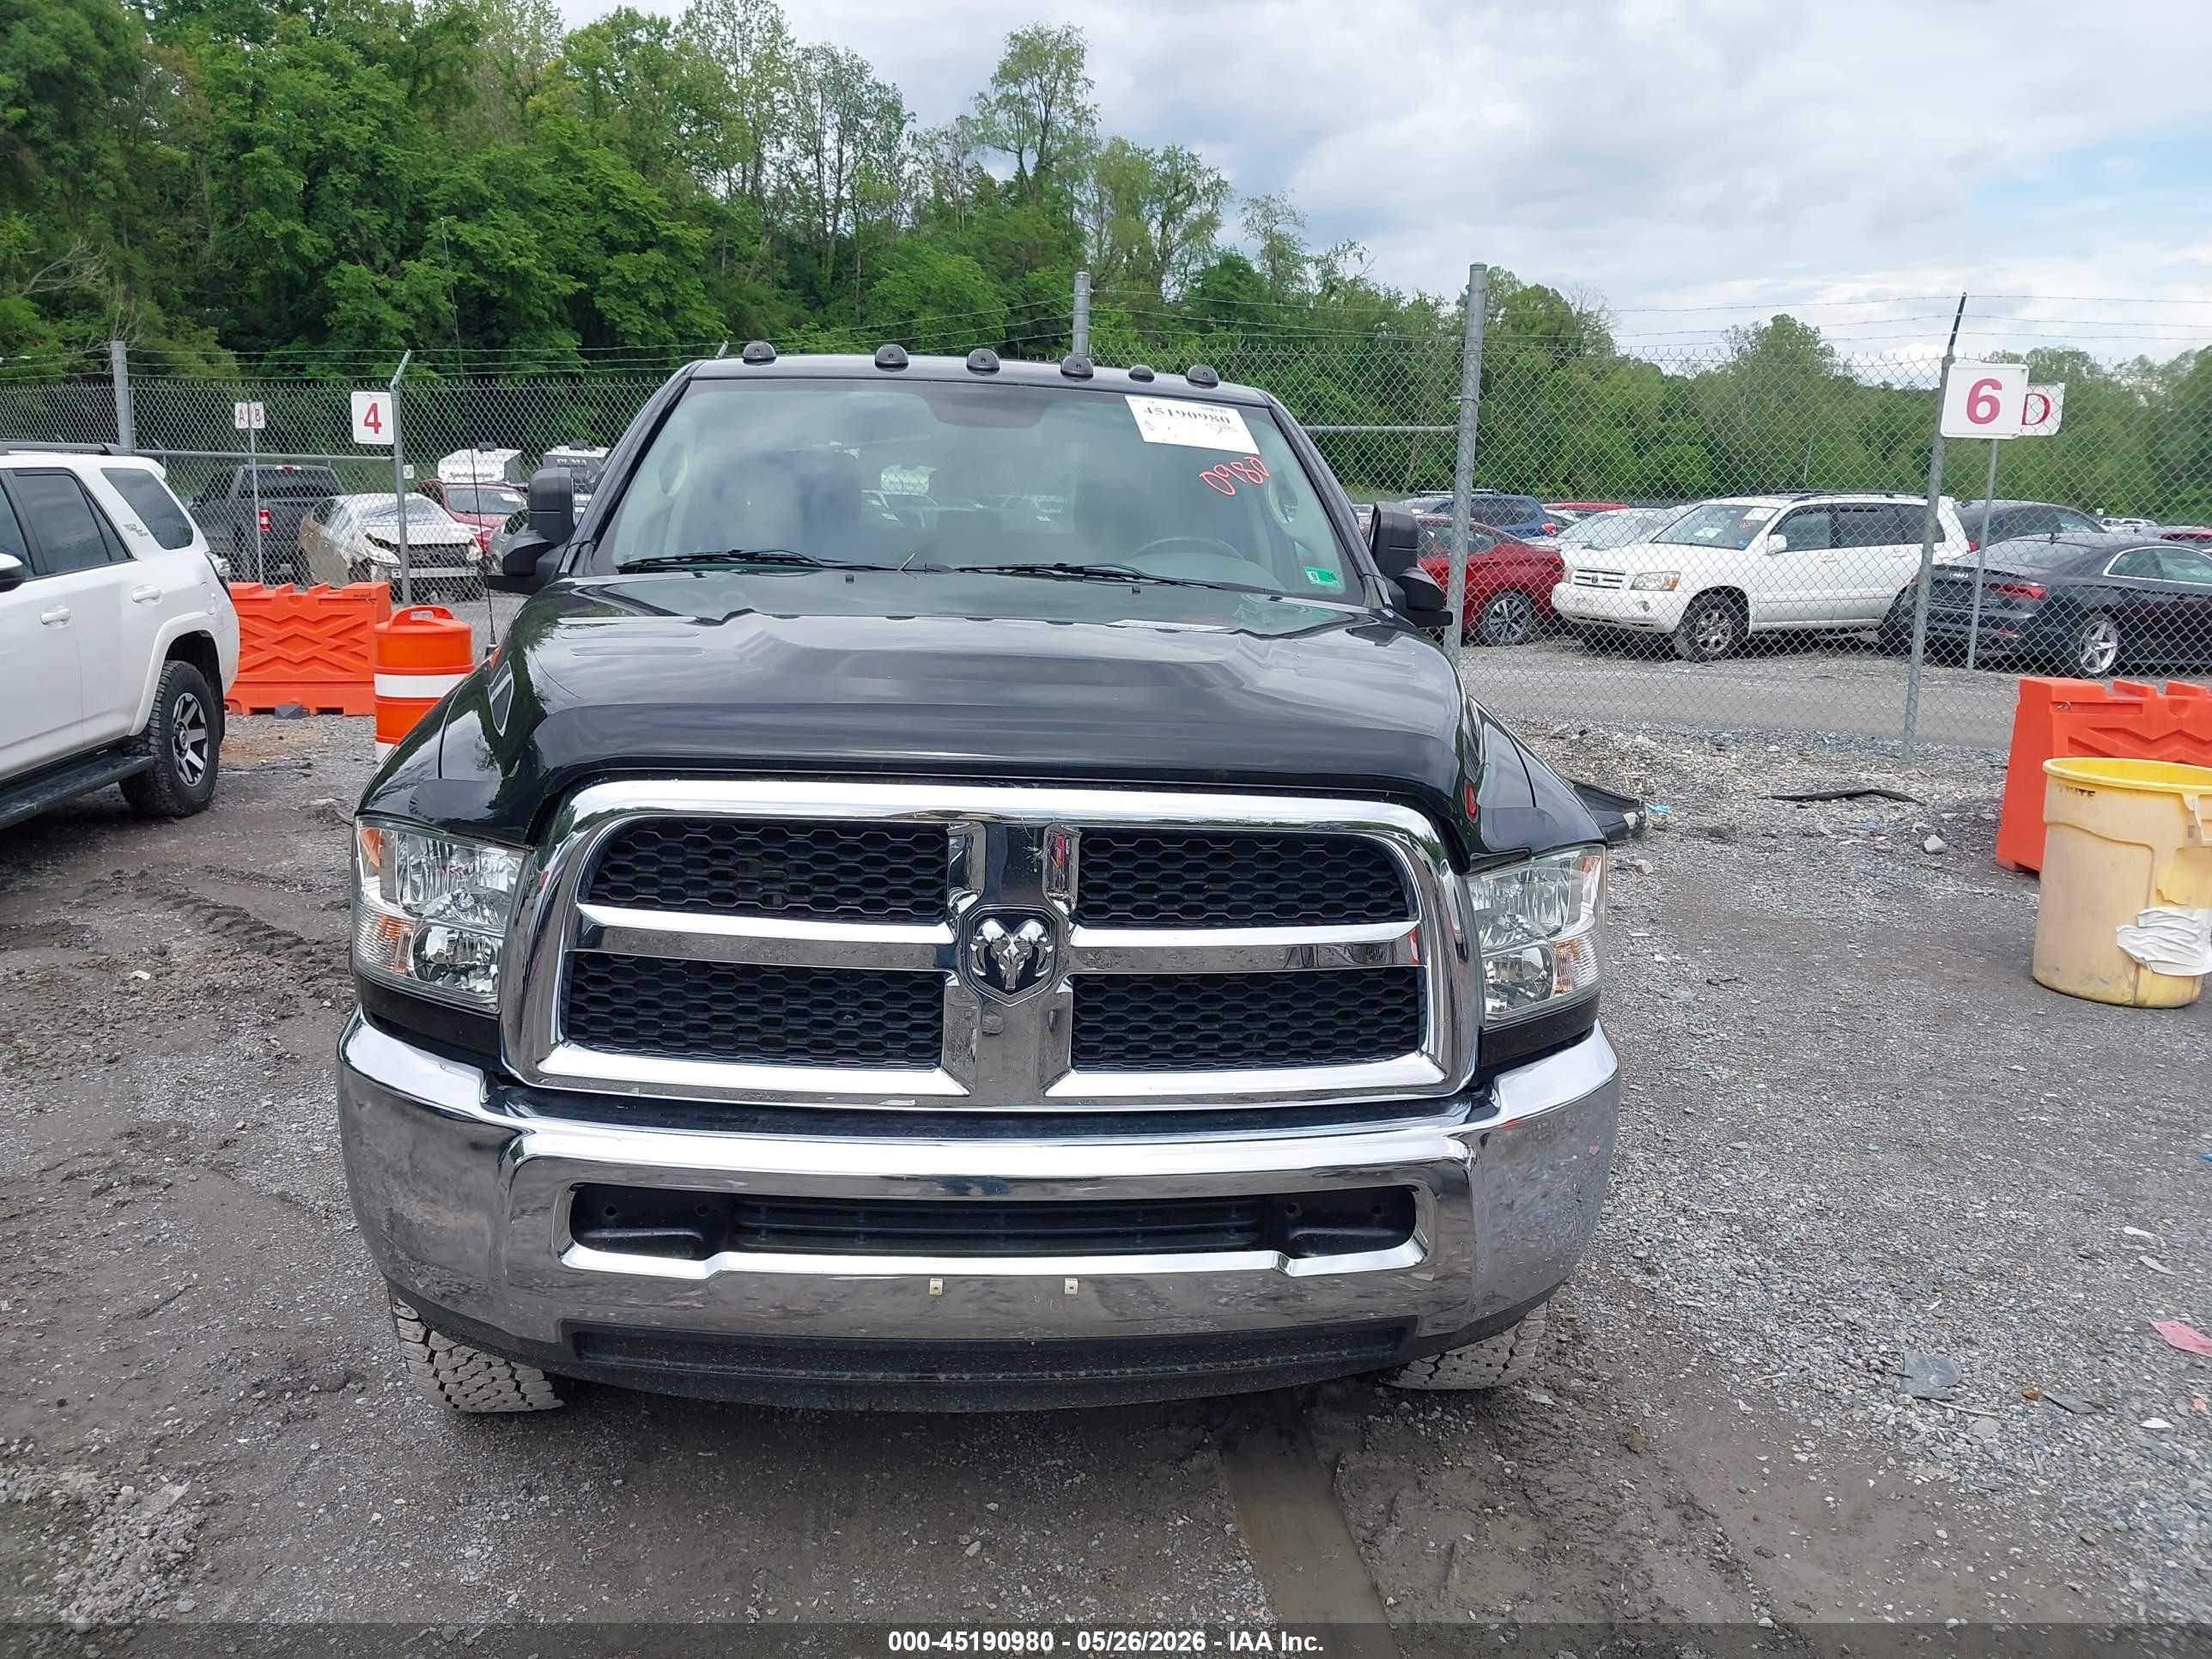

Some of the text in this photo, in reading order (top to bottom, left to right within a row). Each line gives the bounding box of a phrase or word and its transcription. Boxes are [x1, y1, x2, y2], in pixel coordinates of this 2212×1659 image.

[363, 402, 383, 434] 4
[1143, 406, 1231, 424] 45190980
[1966, 378, 2002, 424] 6
[2021, 392, 2051, 426] D
[1199, 456, 1269, 496] 0980
